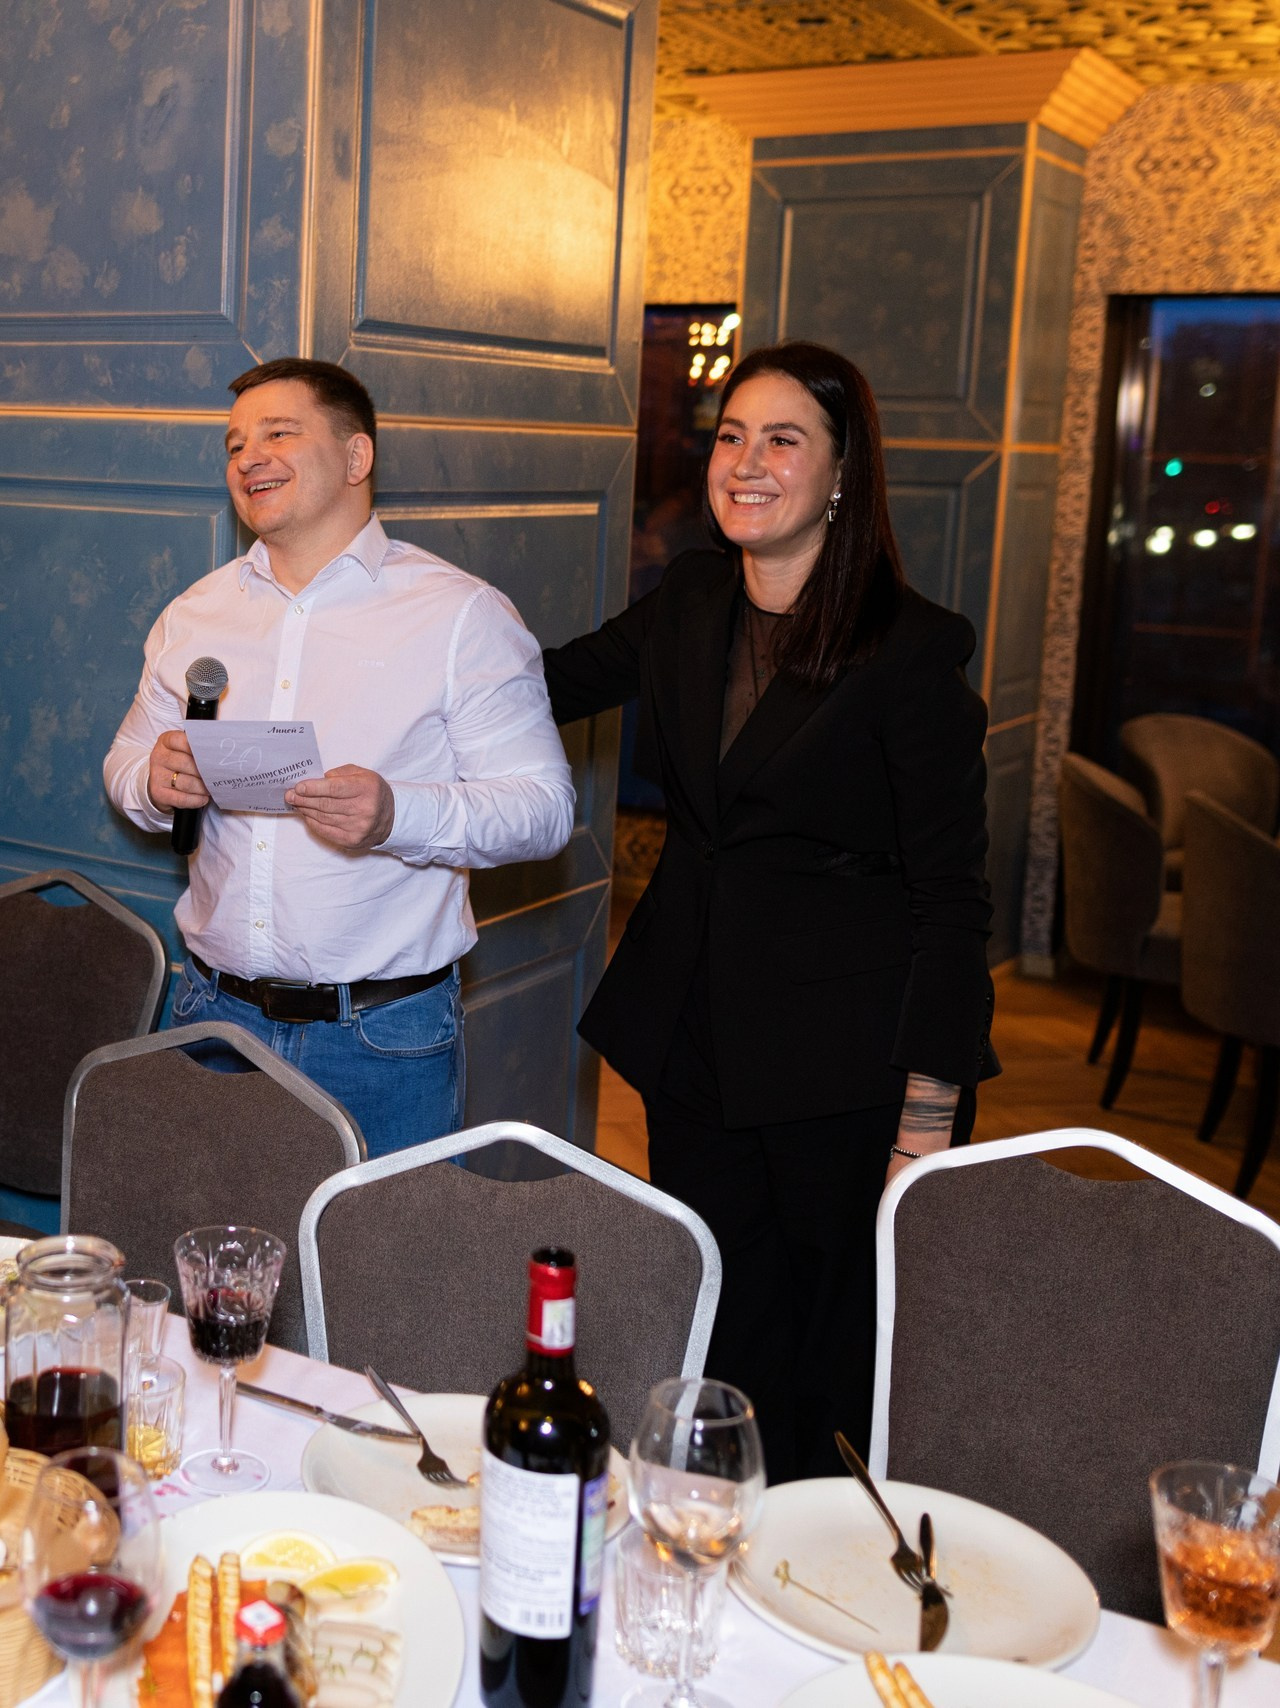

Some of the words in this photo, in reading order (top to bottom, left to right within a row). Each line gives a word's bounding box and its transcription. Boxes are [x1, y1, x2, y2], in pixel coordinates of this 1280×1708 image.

[298, 726, 305, 734] 2
[212, 777, 249, 788] ВСТРЕЧА
[250, 758, 314, 782] ВЫПУСКНИКОВ
[268, 769, 308, 785] спустя
